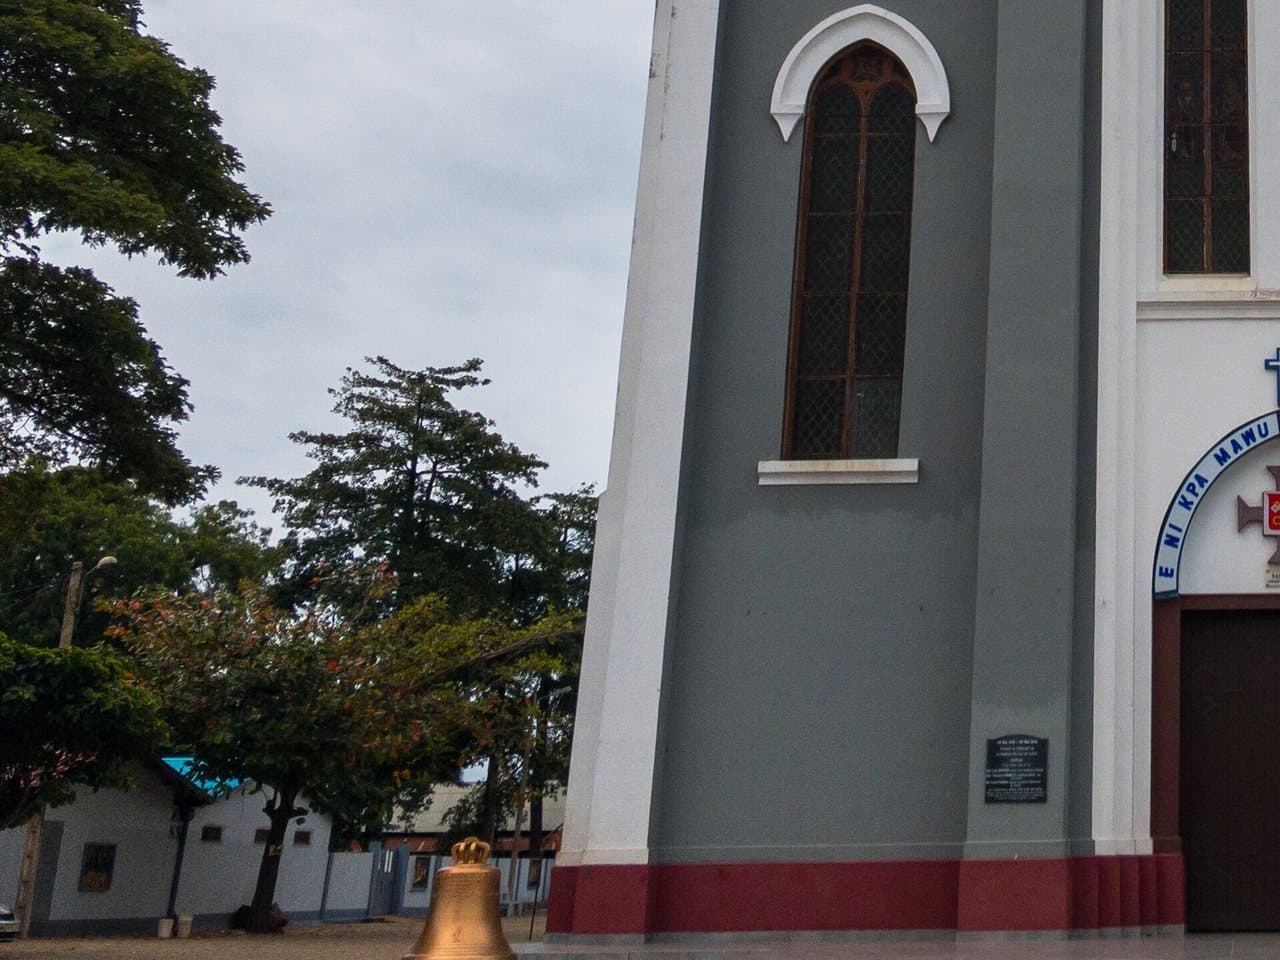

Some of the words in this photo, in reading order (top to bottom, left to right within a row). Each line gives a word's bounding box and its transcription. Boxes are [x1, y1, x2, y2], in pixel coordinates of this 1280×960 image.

[1213, 421, 1270, 466] MAWU
[1178, 472, 1209, 511] KPA
[1163, 524, 1183, 549] NI
[1158, 566, 1174, 578] E
